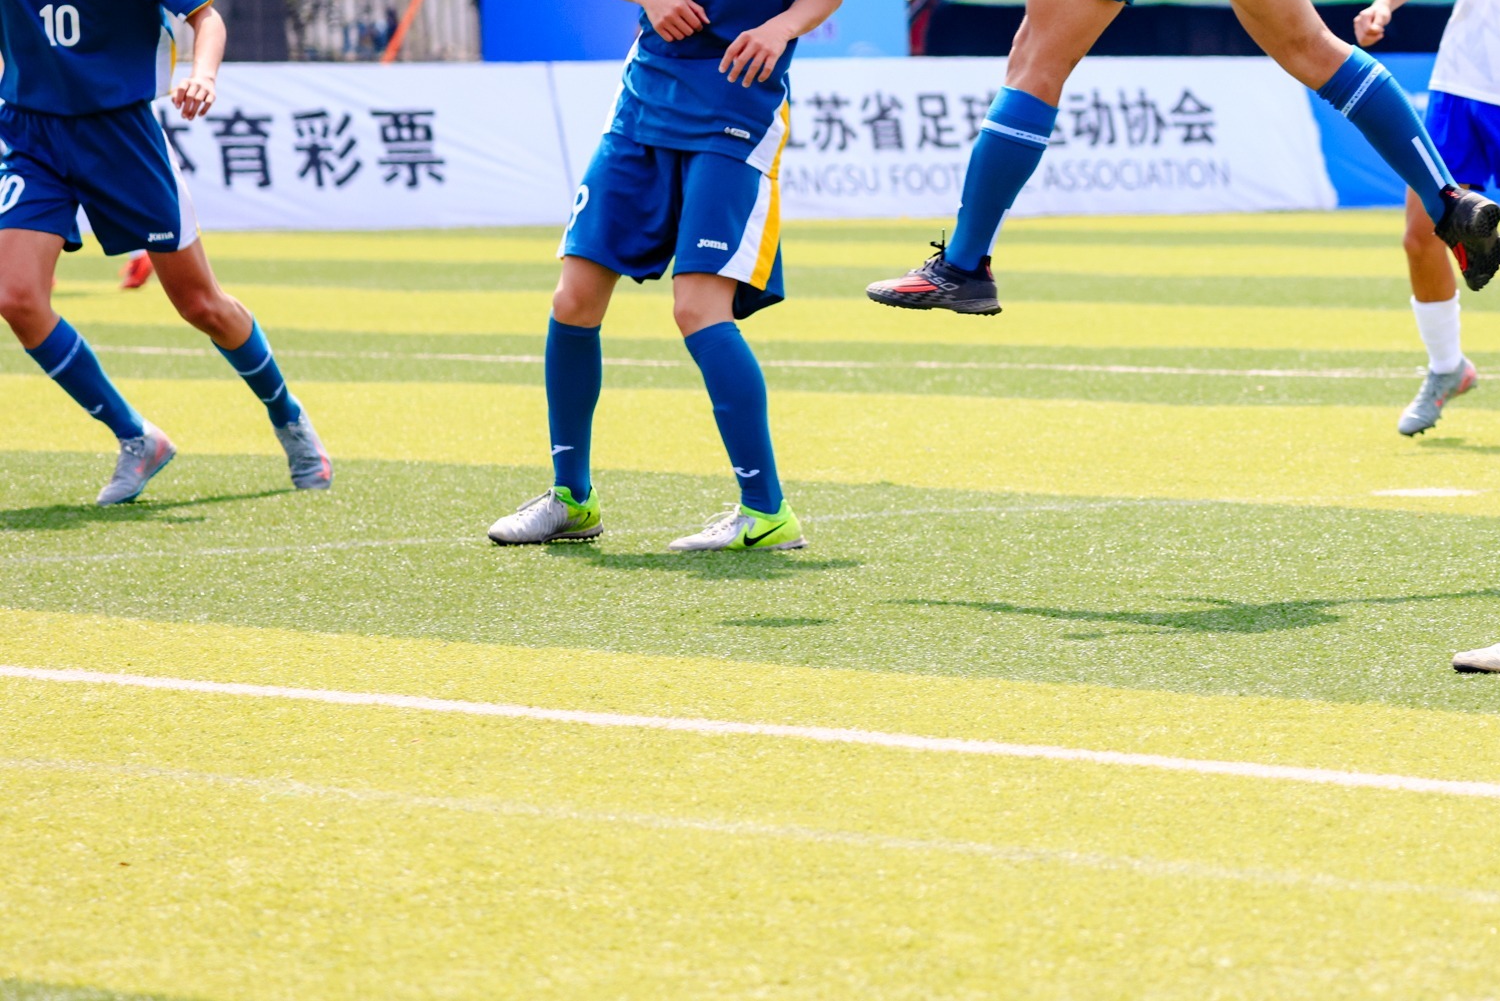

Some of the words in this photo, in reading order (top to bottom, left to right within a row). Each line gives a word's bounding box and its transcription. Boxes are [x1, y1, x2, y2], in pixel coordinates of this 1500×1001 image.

[39, 3, 81, 47] 10
[787, 88, 1215, 151] 苏省足动协会
[783, 160, 880, 195] ANGSU
[1043, 157, 1231, 192] ASSOCIATION
[569, 184, 590, 231] 9
